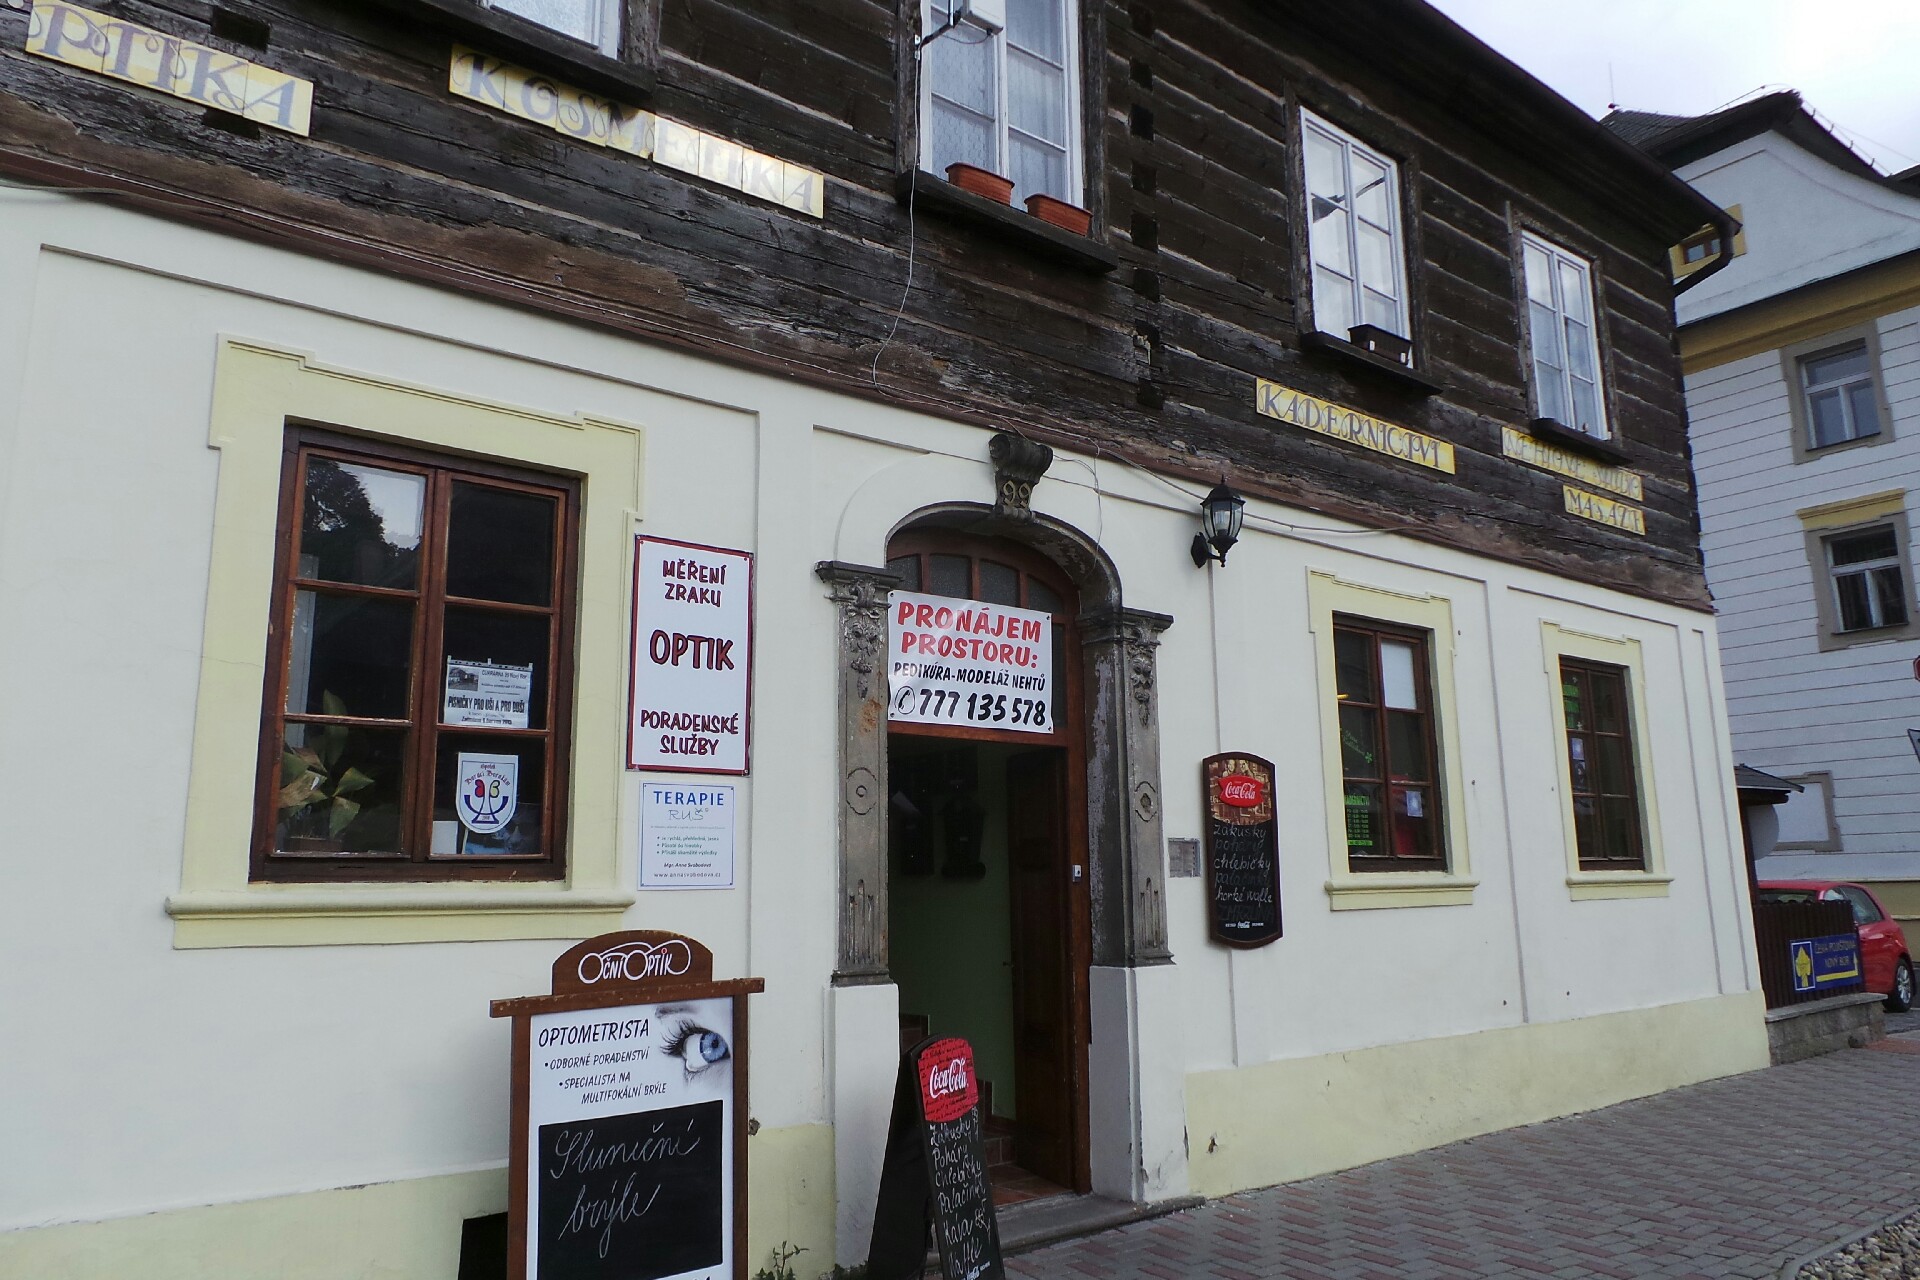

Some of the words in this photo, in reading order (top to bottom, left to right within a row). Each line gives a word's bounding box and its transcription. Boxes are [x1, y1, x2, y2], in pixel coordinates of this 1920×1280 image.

[662, 558, 727, 585] MĚŘENÍ
[664, 582, 722, 608] ZRAKU
[897, 600, 1042, 643] PRONÁJEM
[649, 629, 735, 671] OPTIK
[901, 631, 1038, 669] PROSTORU:
[1011, 673, 1046, 692] NEHTŮ
[474, 698, 484, 710] PRO
[484, 698, 494, 710] UŠI
[494, 700, 500, 710] A
[500, 700, 512, 712] PRO
[919, 688, 961, 719] 777
[966, 692, 1007, 723] 135
[1011, 697, 1046, 727] 578
[640, 708, 739, 735] PORADENSKÉ
[659, 733, 720, 756] SLUŽBY
[652, 790, 725, 806] TERAPIE
[1224, 781, 1257, 800] Coca-Cola
[538, 1018, 649, 1048] OPTOMETRISTA
[550, 1053, 591, 1071] ODBORNÉ
[592, 1046, 651, 1066] PORADENSTVÍ
[564, 1073, 616, 1090] SPECIALISTA
[620, 1072, 630, 1082] NA
[929, 1056, 969, 1099] Coca-Cola
[581, 1083, 643, 1105] MULTIFOKÁLNÍ
[643, 1080, 667, 1096] BRÝLE
